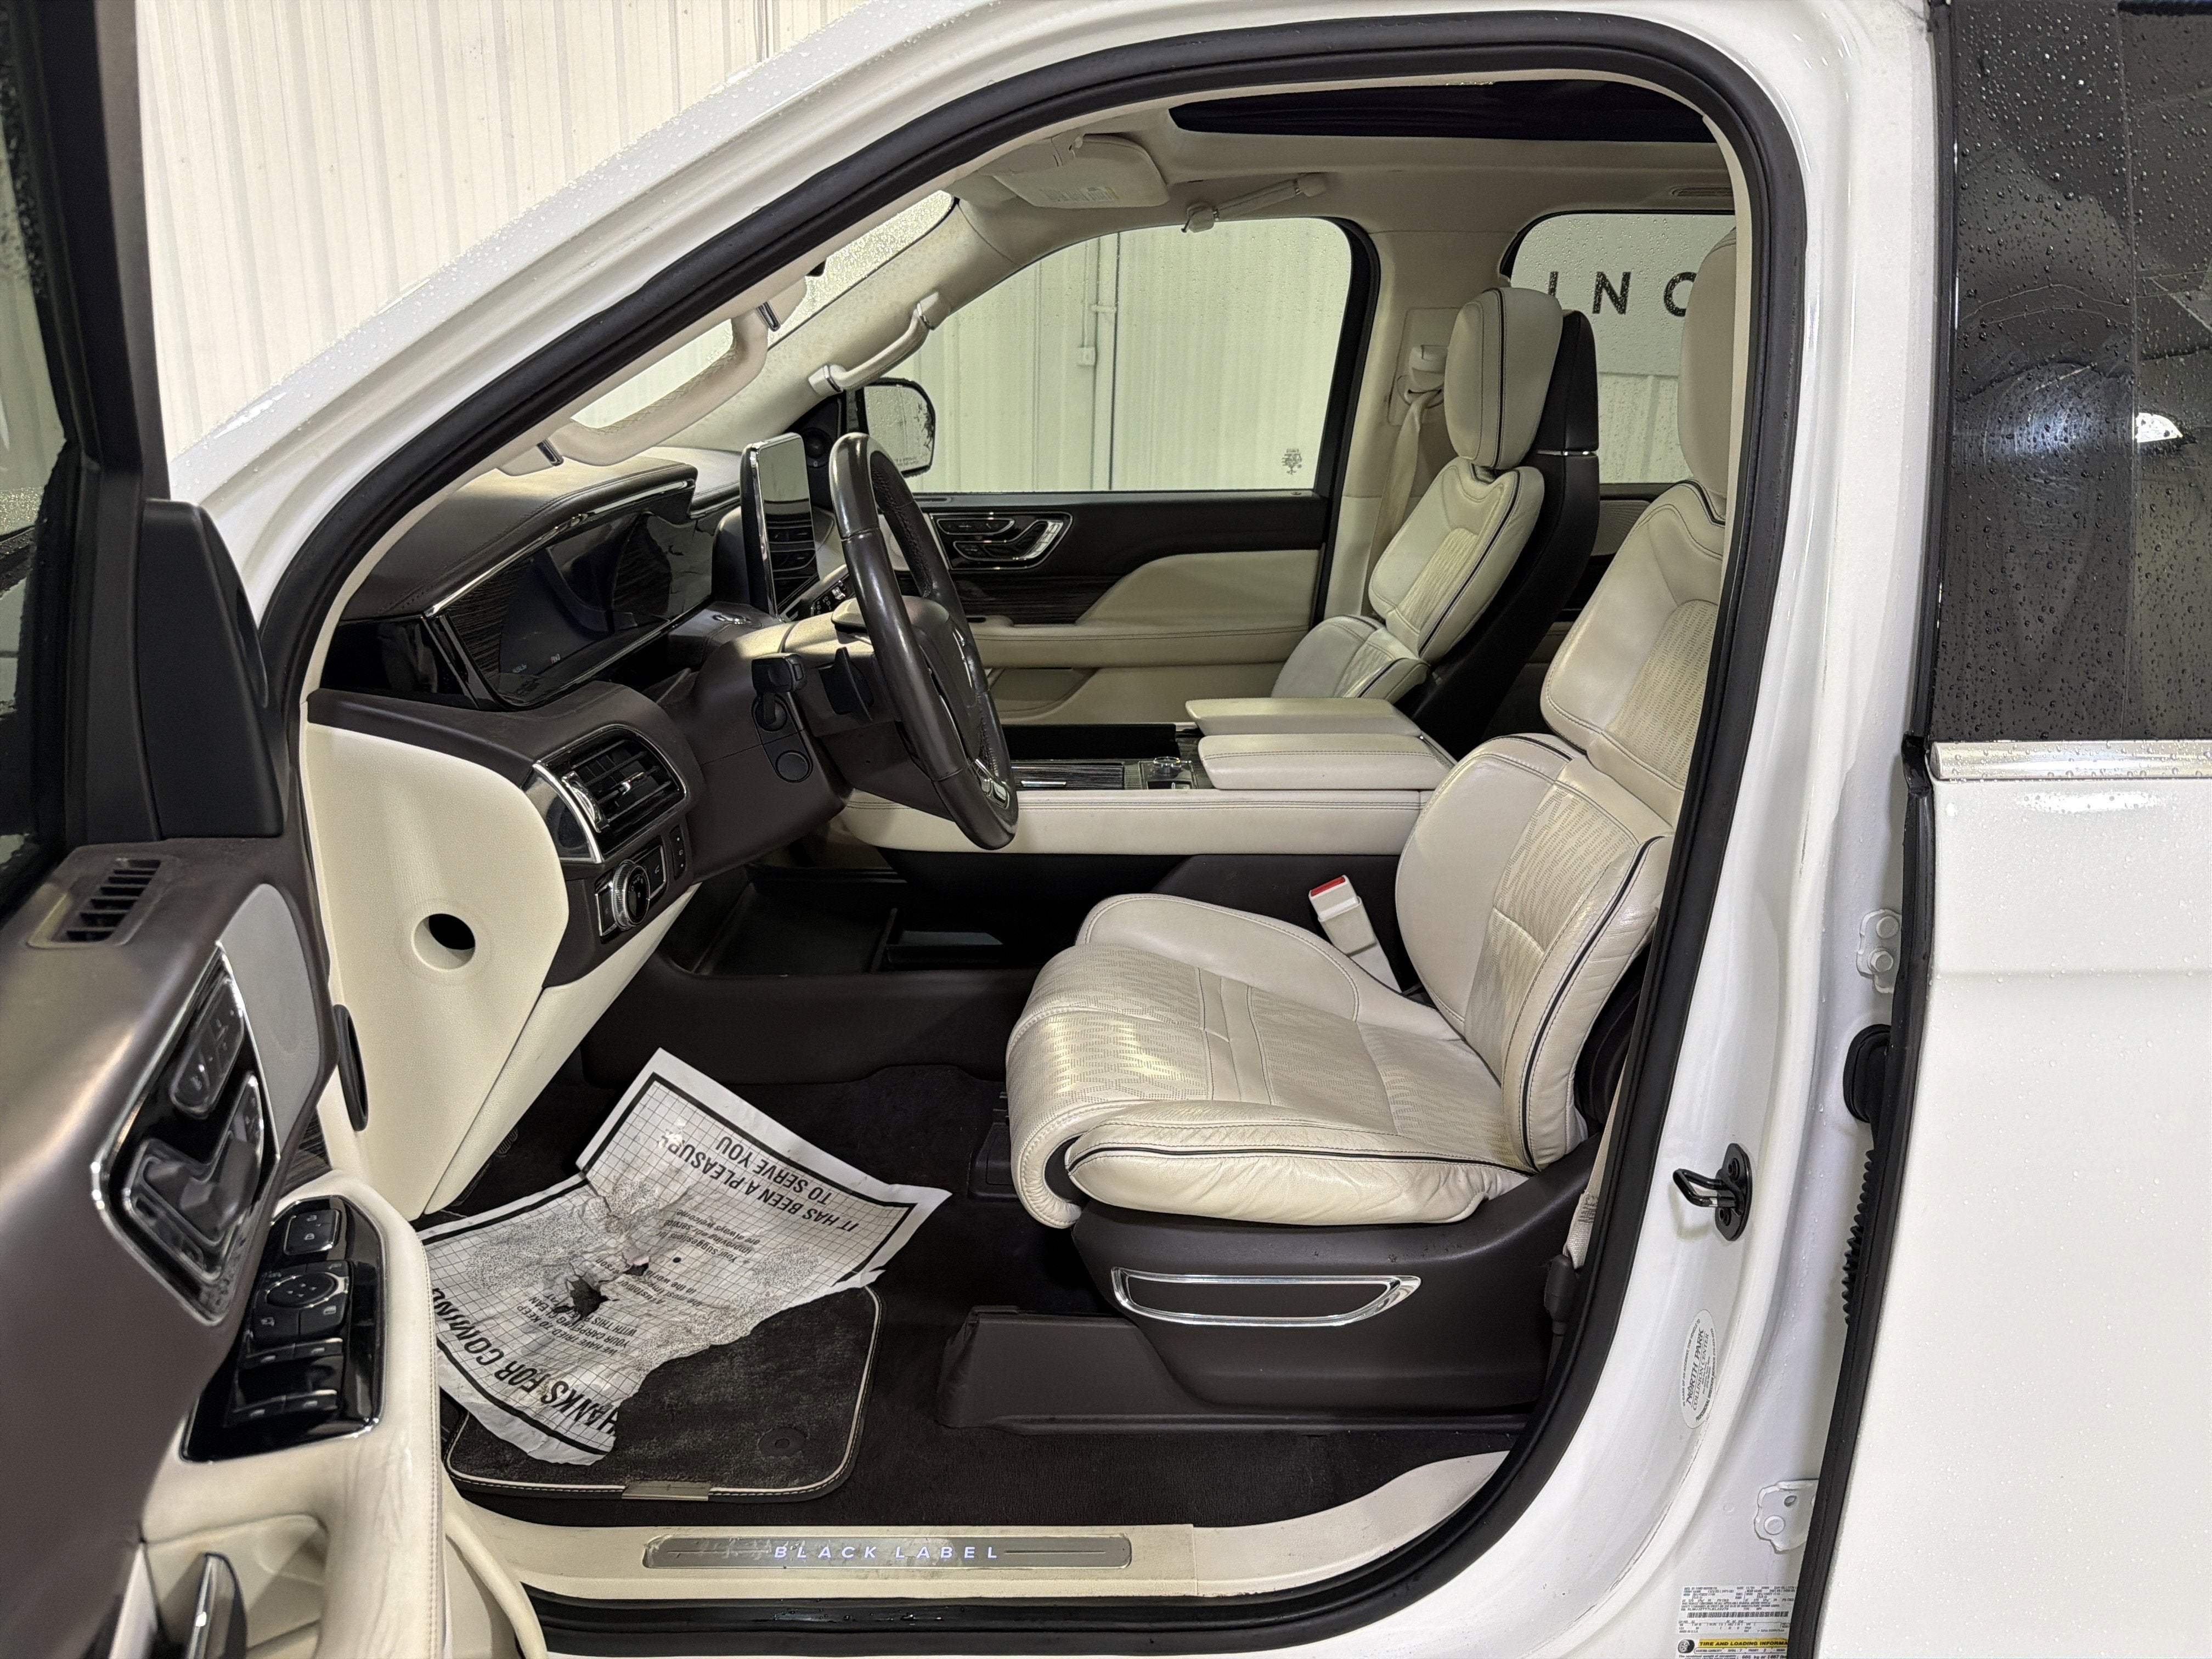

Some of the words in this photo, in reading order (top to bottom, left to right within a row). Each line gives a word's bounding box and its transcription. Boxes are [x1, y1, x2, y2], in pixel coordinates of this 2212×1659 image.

[714, 1136, 752, 1168] YOU
[752, 1158, 808, 1193] SERVE
[744, 1180, 761, 1197] A
[807, 1186, 833, 1205] TO
[757, 1188, 803, 1215] BEEN
[663, 1220, 692, 1231] service
[802, 1208, 840, 1227] HAS
[691, 1227, 709, 1237] our
[713, 1224, 744, 1240] always
[833, 1220, 860, 1232] IT
[656, 1231, 669, 1240] for
[668, 1233, 716, 1255] suggestions
[708, 1234, 753, 1256] improving
[718, 1251, 738, 1263] Your
[617, 1279, 657, 1303] customer
[670, 1282, 686, 1292] the
[687, 1297, 702, 1307] the
[517, 1305, 541, 1323] KEEP
[539, 1321, 554, 1331] TO
[590, 1315, 614, 1331] THIS
[614, 1324, 637, 1337] WITH
[552, 1329, 578, 1343] TRIED
[604, 1334, 630, 1348] YOUR
[579, 1338, 603, 1351] HAVE
[602, 1346, 618, 1355] WE
[1686, 1361, 1699, 1405] NORTH
[1694, 1327, 1704, 1361] PARK
[494, 1360, 551, 1393] FOR
[1692, 1366, 1704, 1411] COLLISION
[774, 1545, 878, 1560] BLACK
[896, 1545, 998, 1560] LABEL
